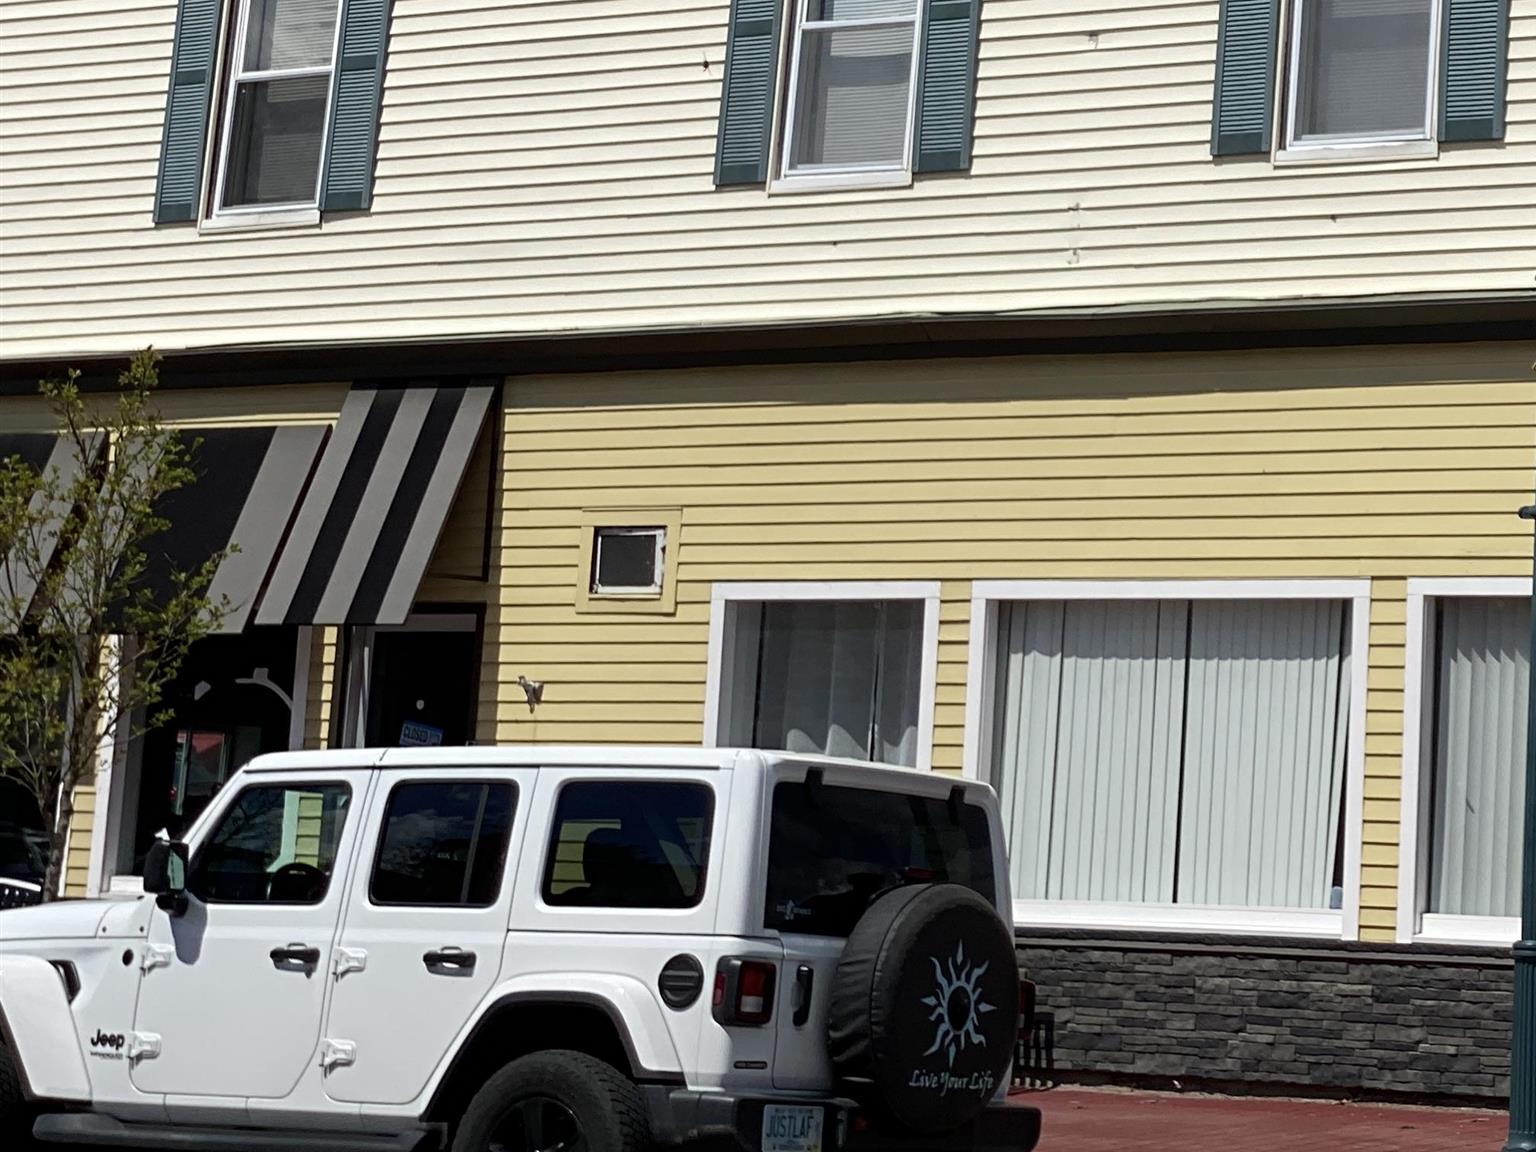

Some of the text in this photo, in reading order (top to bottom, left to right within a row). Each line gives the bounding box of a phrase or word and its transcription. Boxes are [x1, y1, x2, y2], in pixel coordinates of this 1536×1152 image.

[91, 1029, 125, 1051] Jeep
[908, 1069, 993, 1098] Live Your Life
